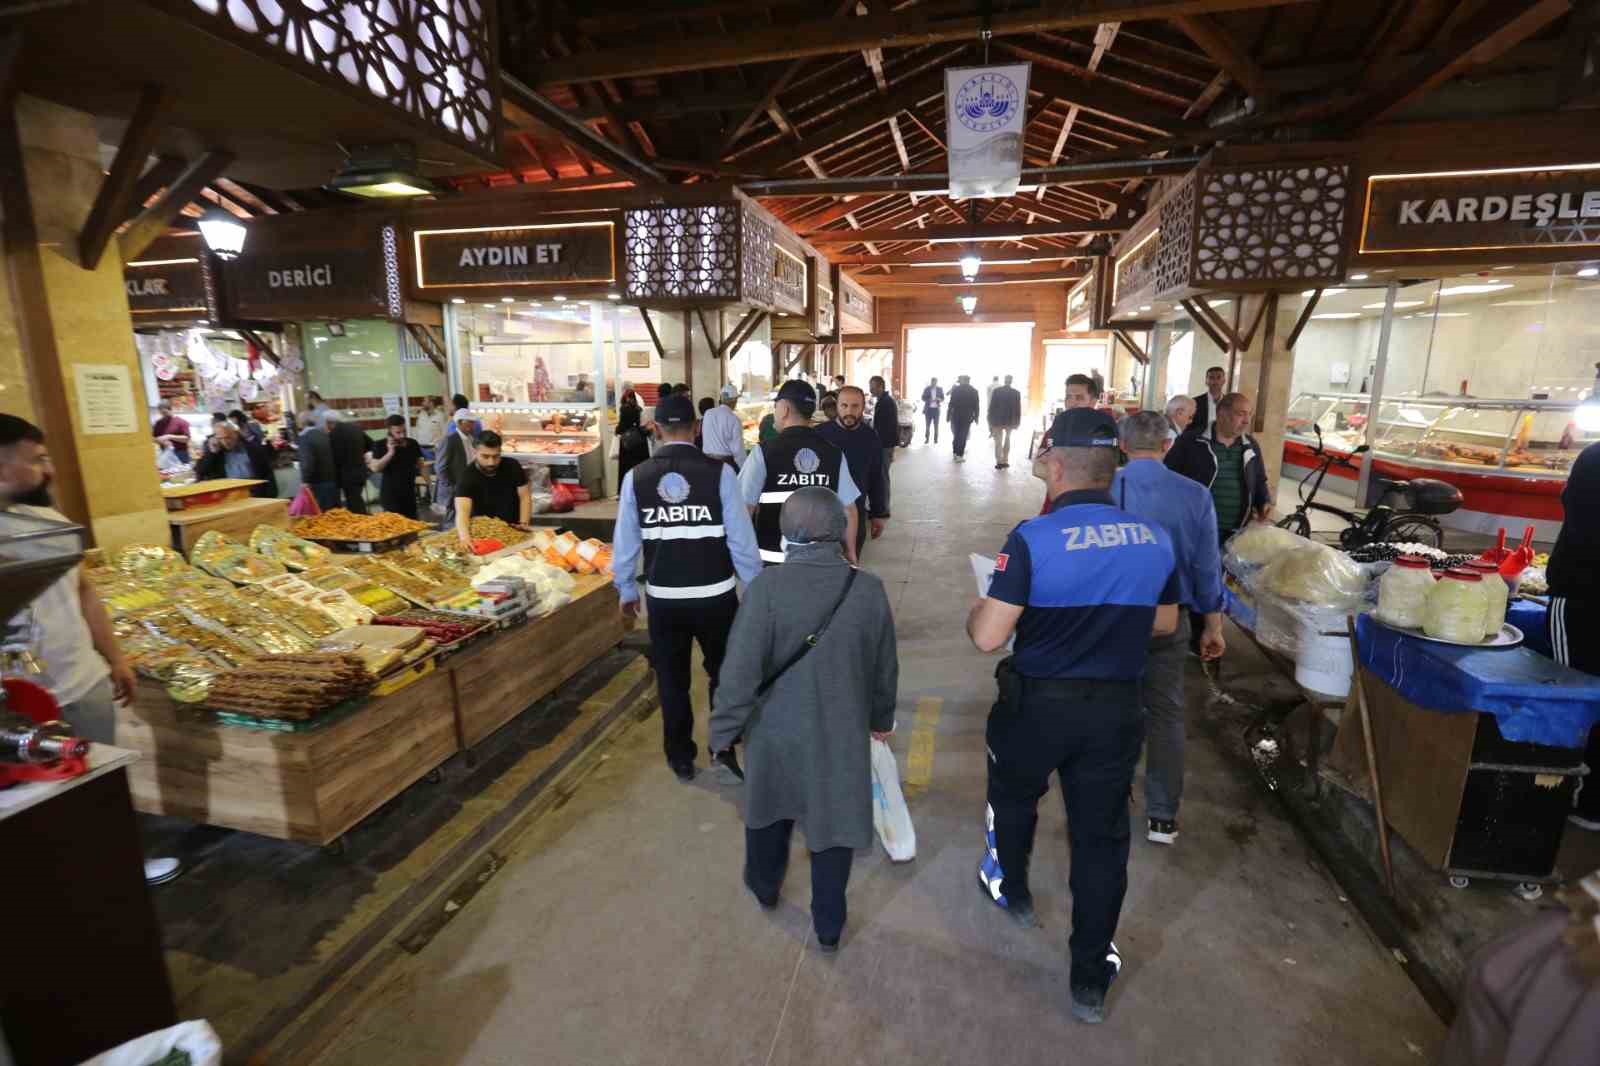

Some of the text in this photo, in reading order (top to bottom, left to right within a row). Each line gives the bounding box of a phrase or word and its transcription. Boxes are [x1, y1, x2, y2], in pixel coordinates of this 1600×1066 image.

[1399, 191, 1600, 227] KARDEŞLE
[459, 244, 562, 266] AYDIN ET
[268, 264, 332, 288] DERİCİ
[641, 505, 713, 524] ZABITA
[1061, 522, 1158, 551] ZABITA
